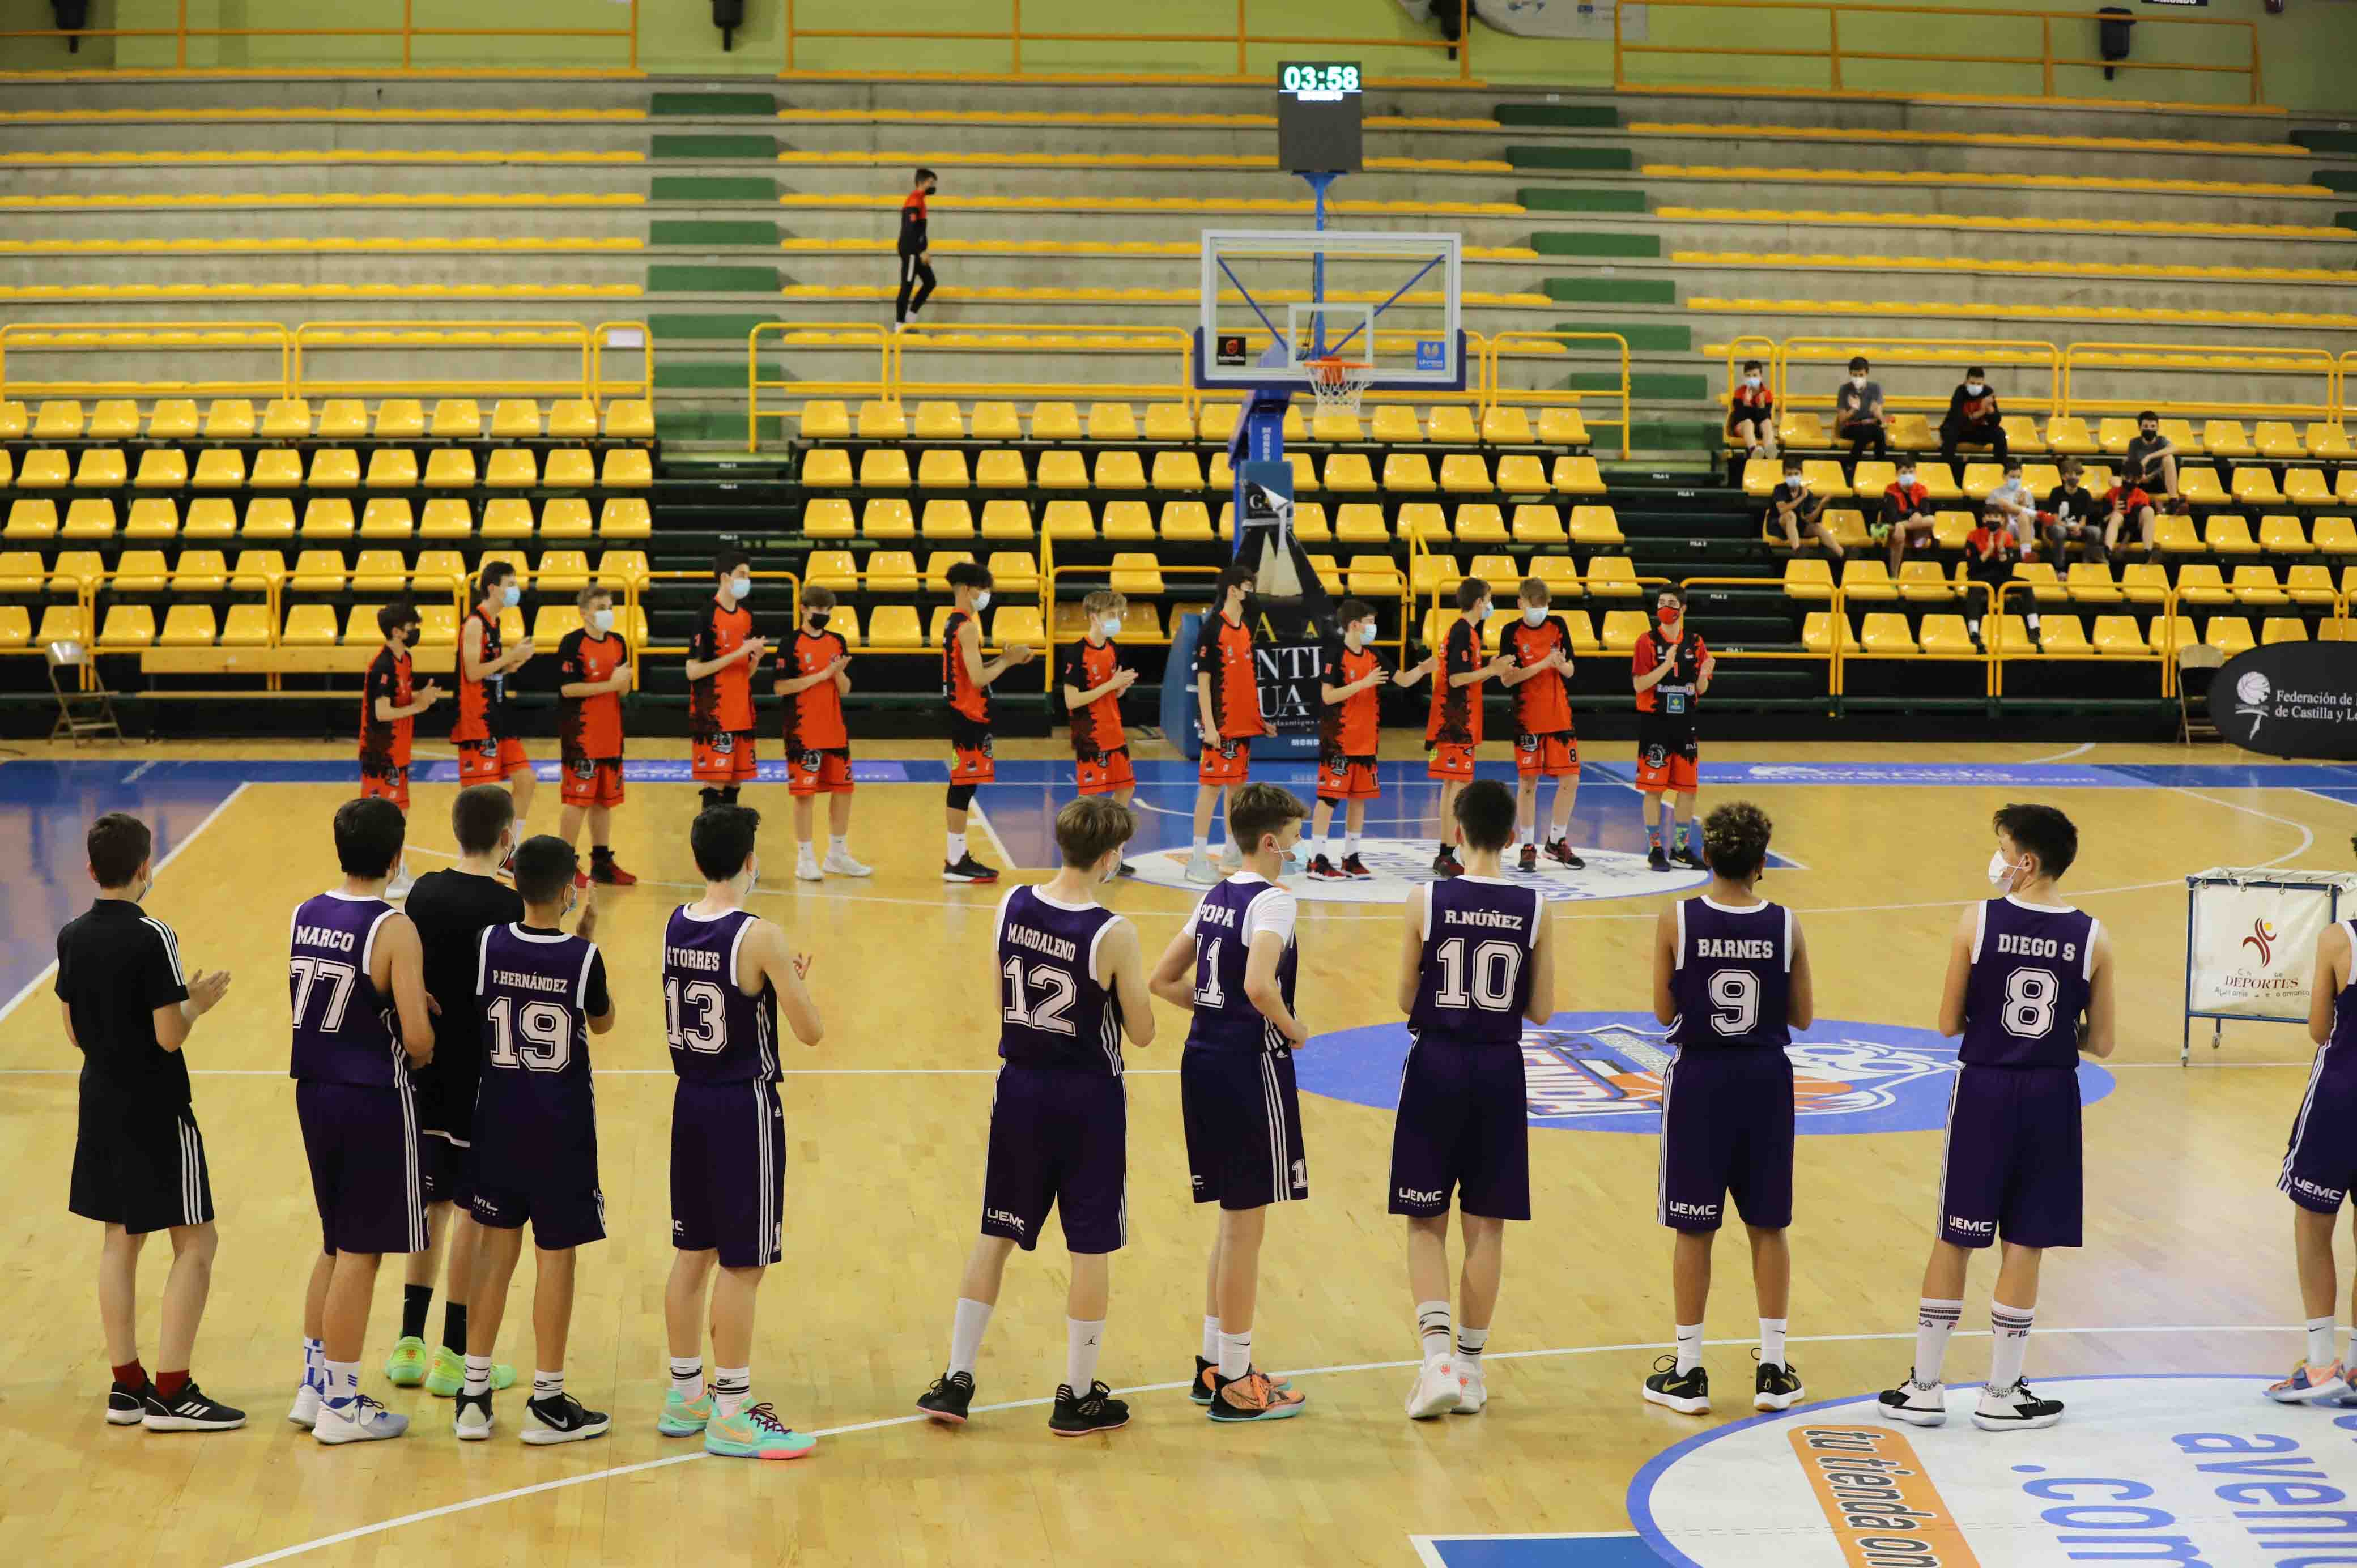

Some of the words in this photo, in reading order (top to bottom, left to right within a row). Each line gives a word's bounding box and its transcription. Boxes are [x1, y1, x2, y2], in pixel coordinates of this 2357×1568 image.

[1284, 66, 1359, 90] 03:58
[2275, 690, 2336, 705] Federación
[2339, 693, 2353, 706] de
[2275, 706, 2288, 718] de
[2291, 706, 2333, 719] Castilla
[2336, 711, 2344, 723] y
[1569, 748, 1577, 763] 8
[1444, 908, 1524, 931] R.NÚÑEZ
[295, 926, 355, 952] MARCO
[1007, 923, 1076, 962] MAGDALENO
[1697, 938, 1774, 959] BARNES
[1998, 933, 2058, 958] DIEGO
[2062, 943, 2077, 962] S
[492, 970, 568, 994] P.HERNÁNDEZ
[1435, 938, 1523, 1012] 10
[2225, 975, 2299, 989] DEPORTES
[290, 956, 356, 1033] 77
[1003, 955, 1076, 1037] 12
[1708, 969, 1760, 1037] 9
[2001, 966, 2059, 1039] 8
[665, 976, 728, 1054] 13
[487, 996, 572, 1073] 19
[1398, 1187, 1443, 1203] UEMC
[2294, 1177, 2343, 1200] UEMC
[987, 1208, 1025, 1232] UEMC
[1669, 1200, 1718, 1216] UEMC
[1949, 1214, 1993, 1232] UEMC
[1816, 1456, 1937, 1531] tienda
